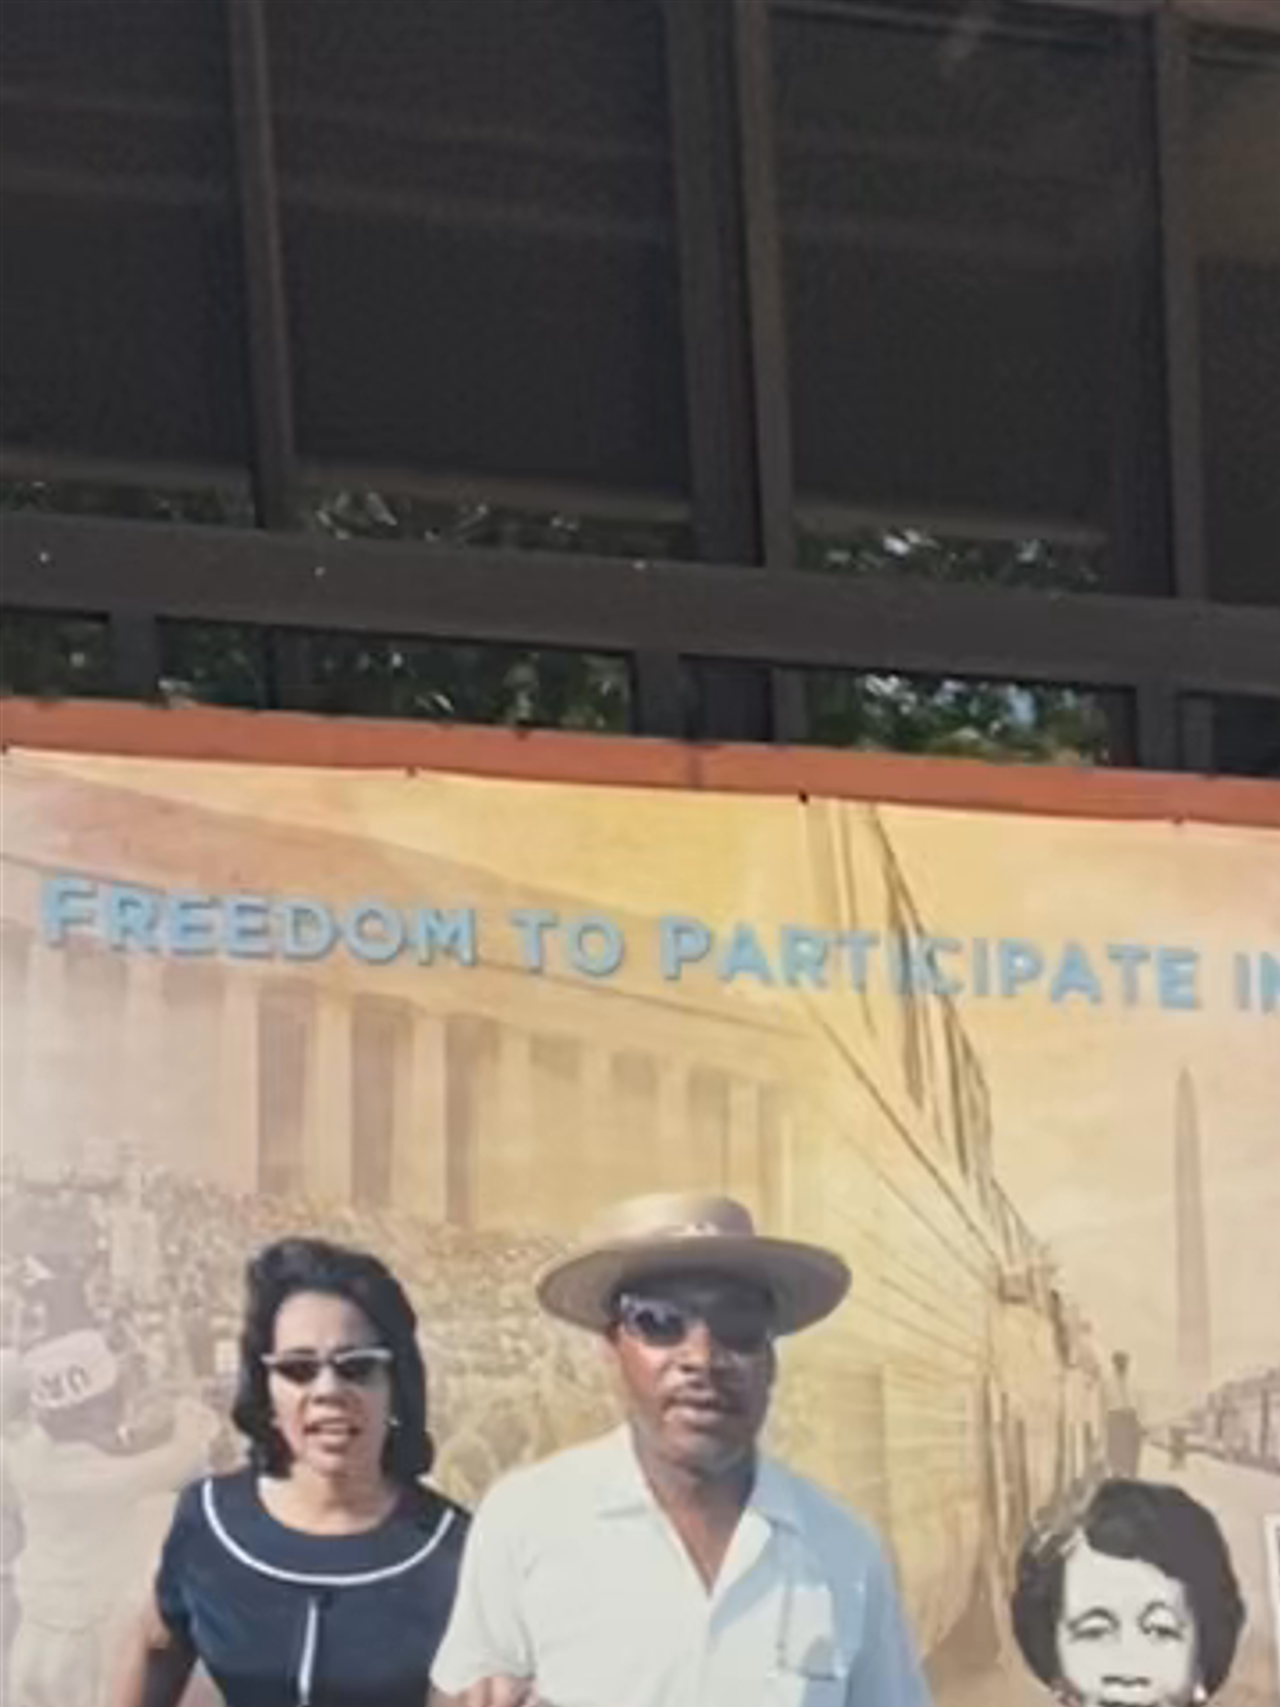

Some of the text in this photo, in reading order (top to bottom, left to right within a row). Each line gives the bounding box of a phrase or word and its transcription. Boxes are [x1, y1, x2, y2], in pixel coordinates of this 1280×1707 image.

[41, 873, 478, 967] FREEDOM
[511, 907, 625, 976] TO
[659, 915, 1201, 1011] PARTICIPATE
